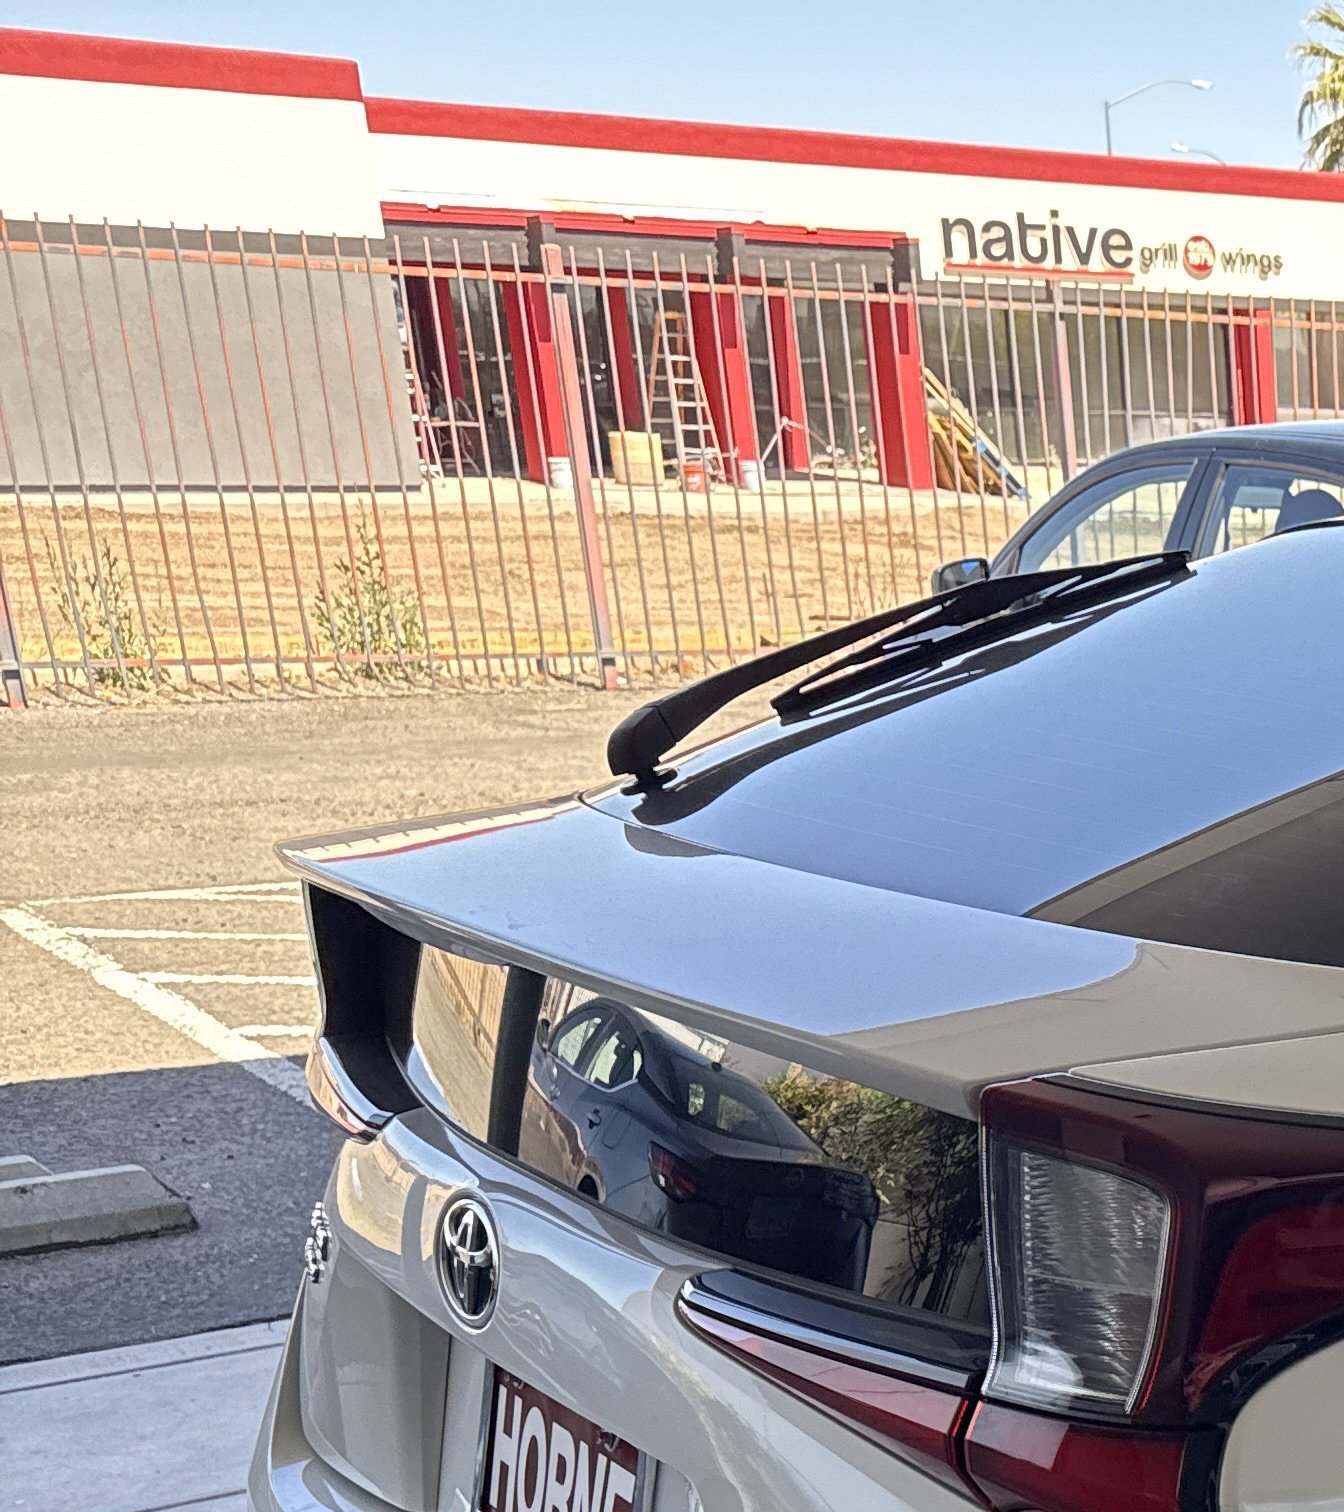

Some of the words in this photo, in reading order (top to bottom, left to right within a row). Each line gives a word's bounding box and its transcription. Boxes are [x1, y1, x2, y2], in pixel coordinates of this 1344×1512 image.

[940, 209, 1134, 269] native
[1139, 242, 1178, 269] grill
[1220, 247, 1283, 276] wings
